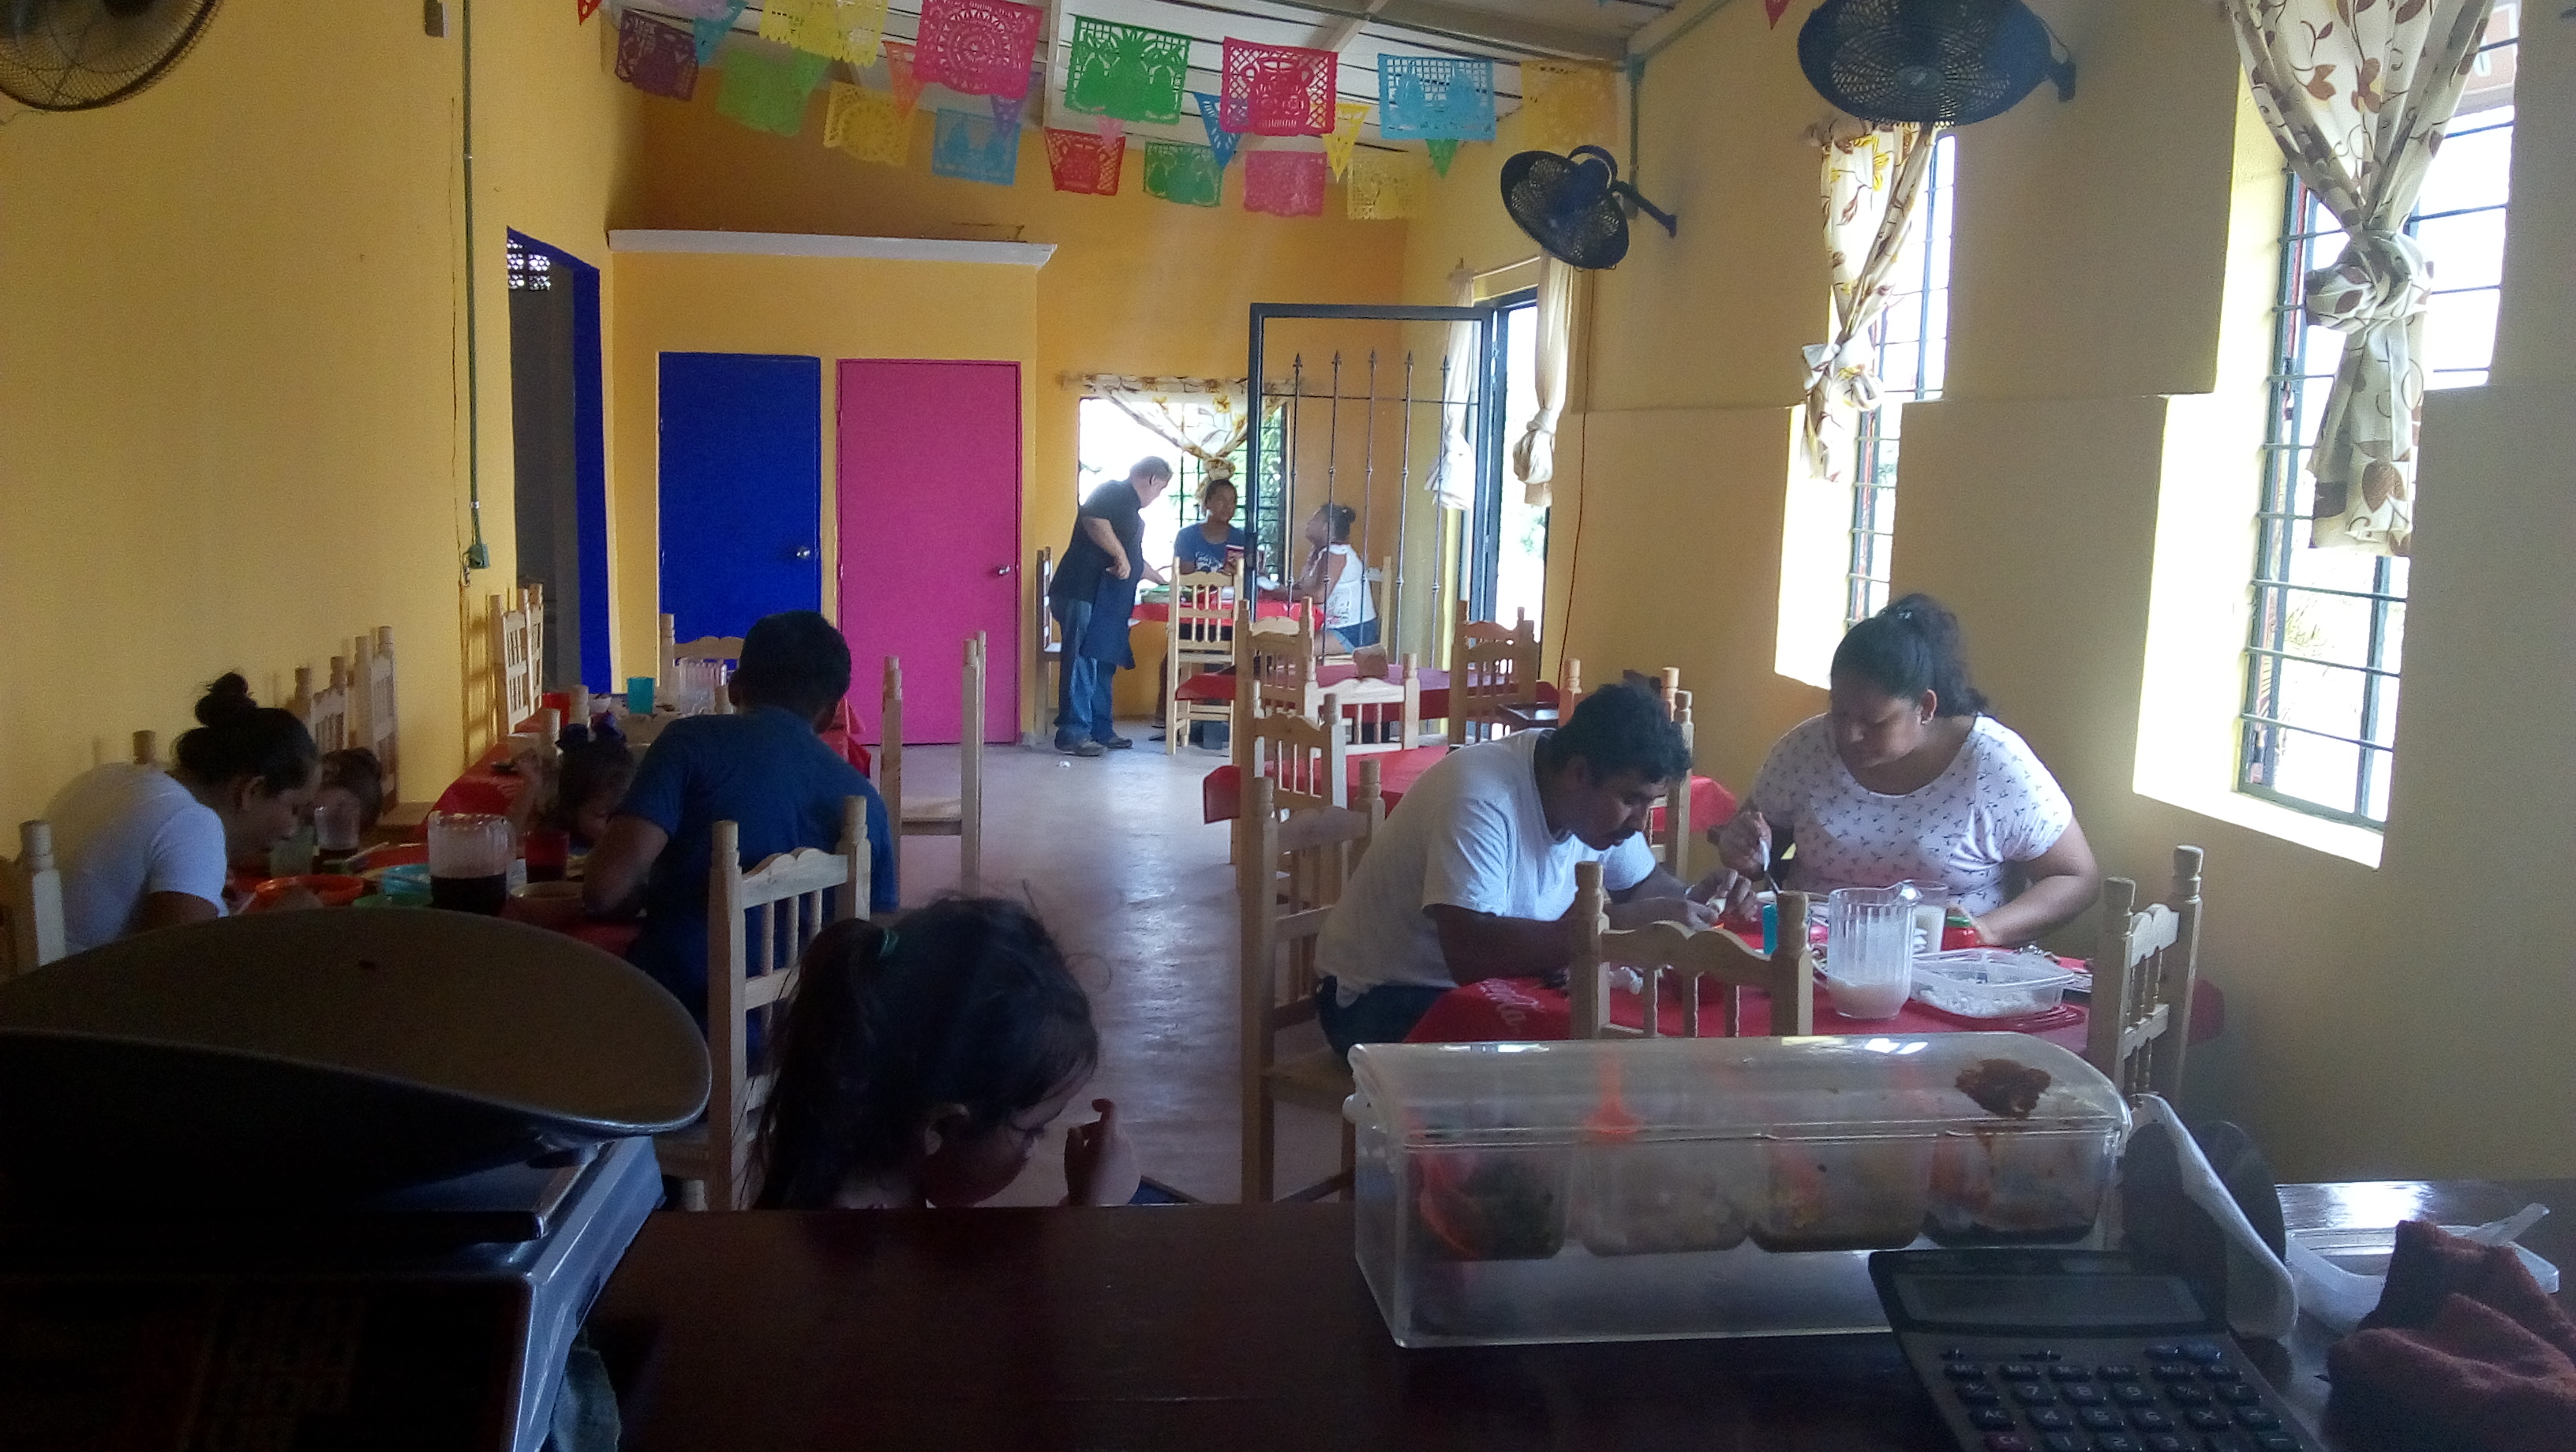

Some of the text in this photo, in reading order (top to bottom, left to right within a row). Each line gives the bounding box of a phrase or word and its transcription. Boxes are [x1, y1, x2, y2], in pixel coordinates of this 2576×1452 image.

[2026, 1385, 2039, 1395] 7
[2126, 1386, 2142, 1396] 9
[1984, 1409, 2007, 1419] AC
[2044, 1410, 2059, 1420] 4
[2094, 1410, 2110, 1421] 5
[2145, 1411, 2161, 1421] 6
[2113, 1436, 2129, 1447] 2
[2162, 1436, 2179, 1448] 3
